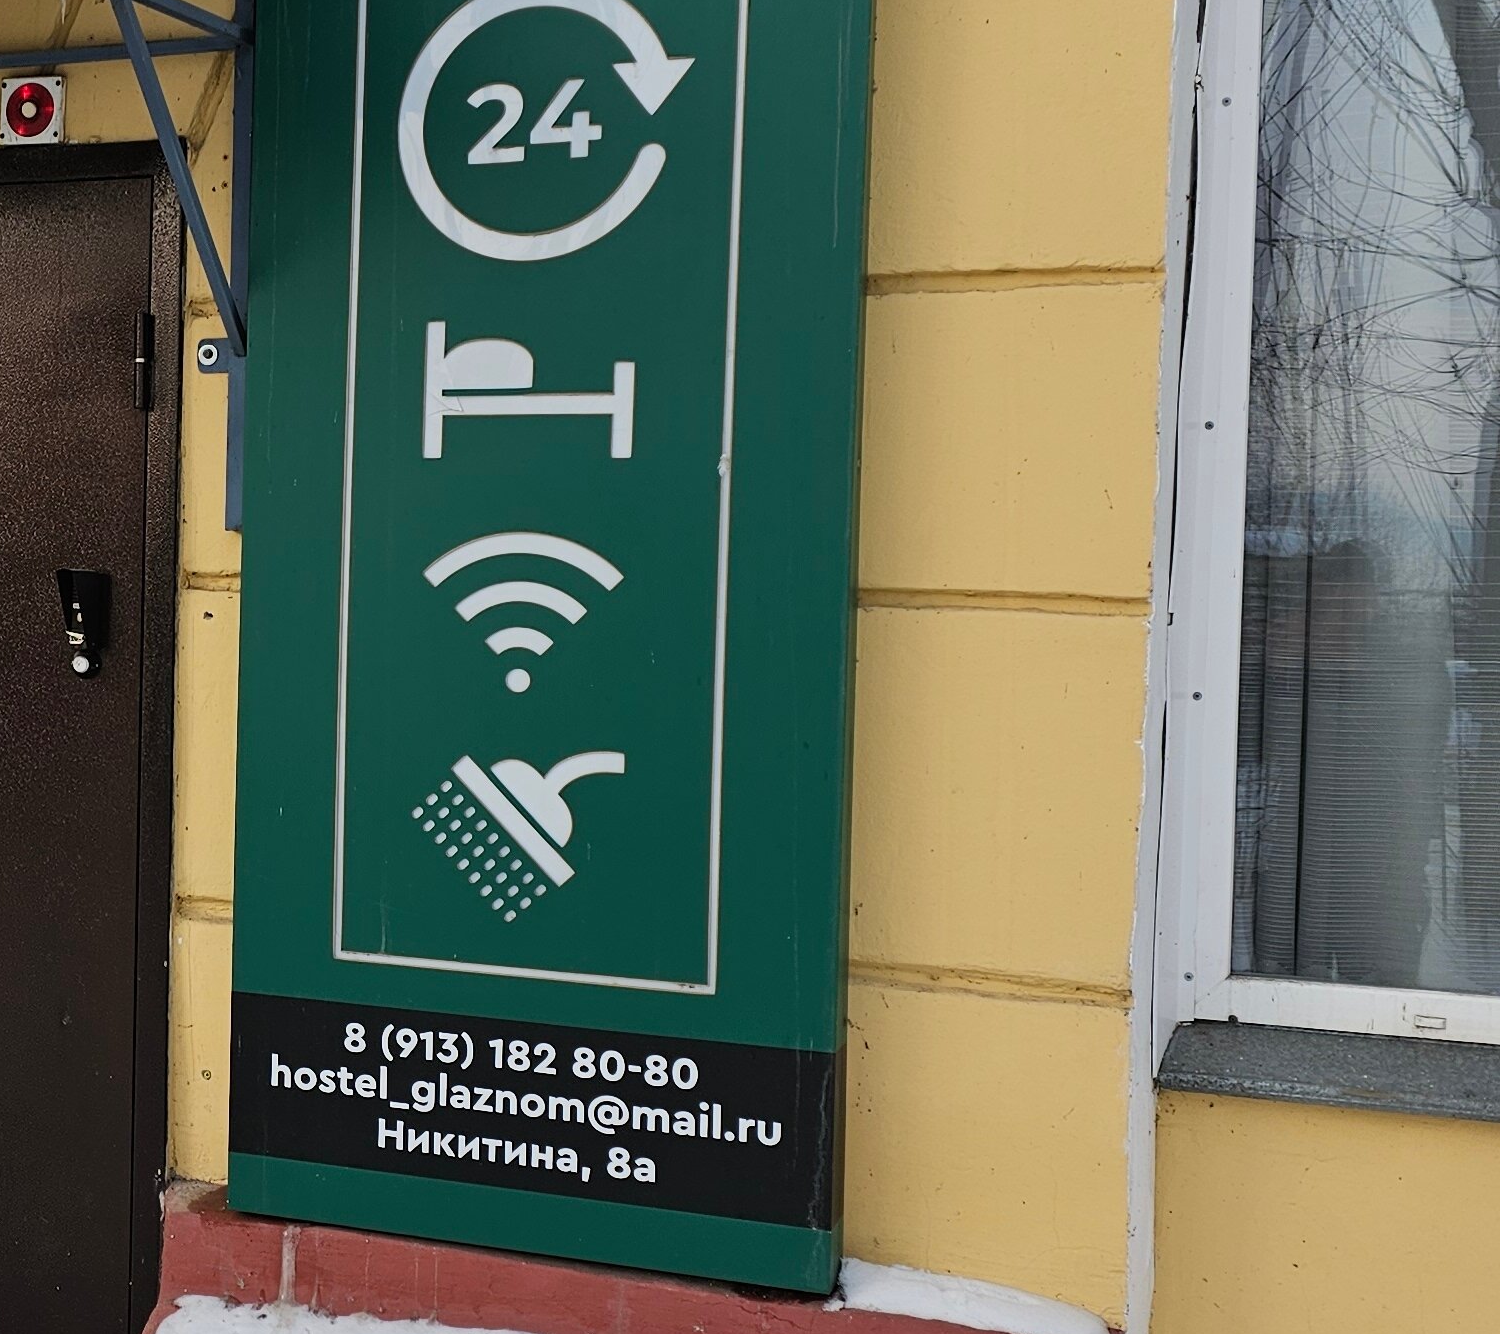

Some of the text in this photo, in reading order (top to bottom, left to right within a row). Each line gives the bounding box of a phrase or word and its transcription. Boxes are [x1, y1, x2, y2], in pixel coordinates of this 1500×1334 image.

[466, 78, 603, 165] 24
[343, 1022, 699, 1090] 8 (913) 182 80-80
[270, 1052, 782, 1147] hostel_glaznom@mail.ru
[377, 1117, 656, 1183] Никитина, 8а
